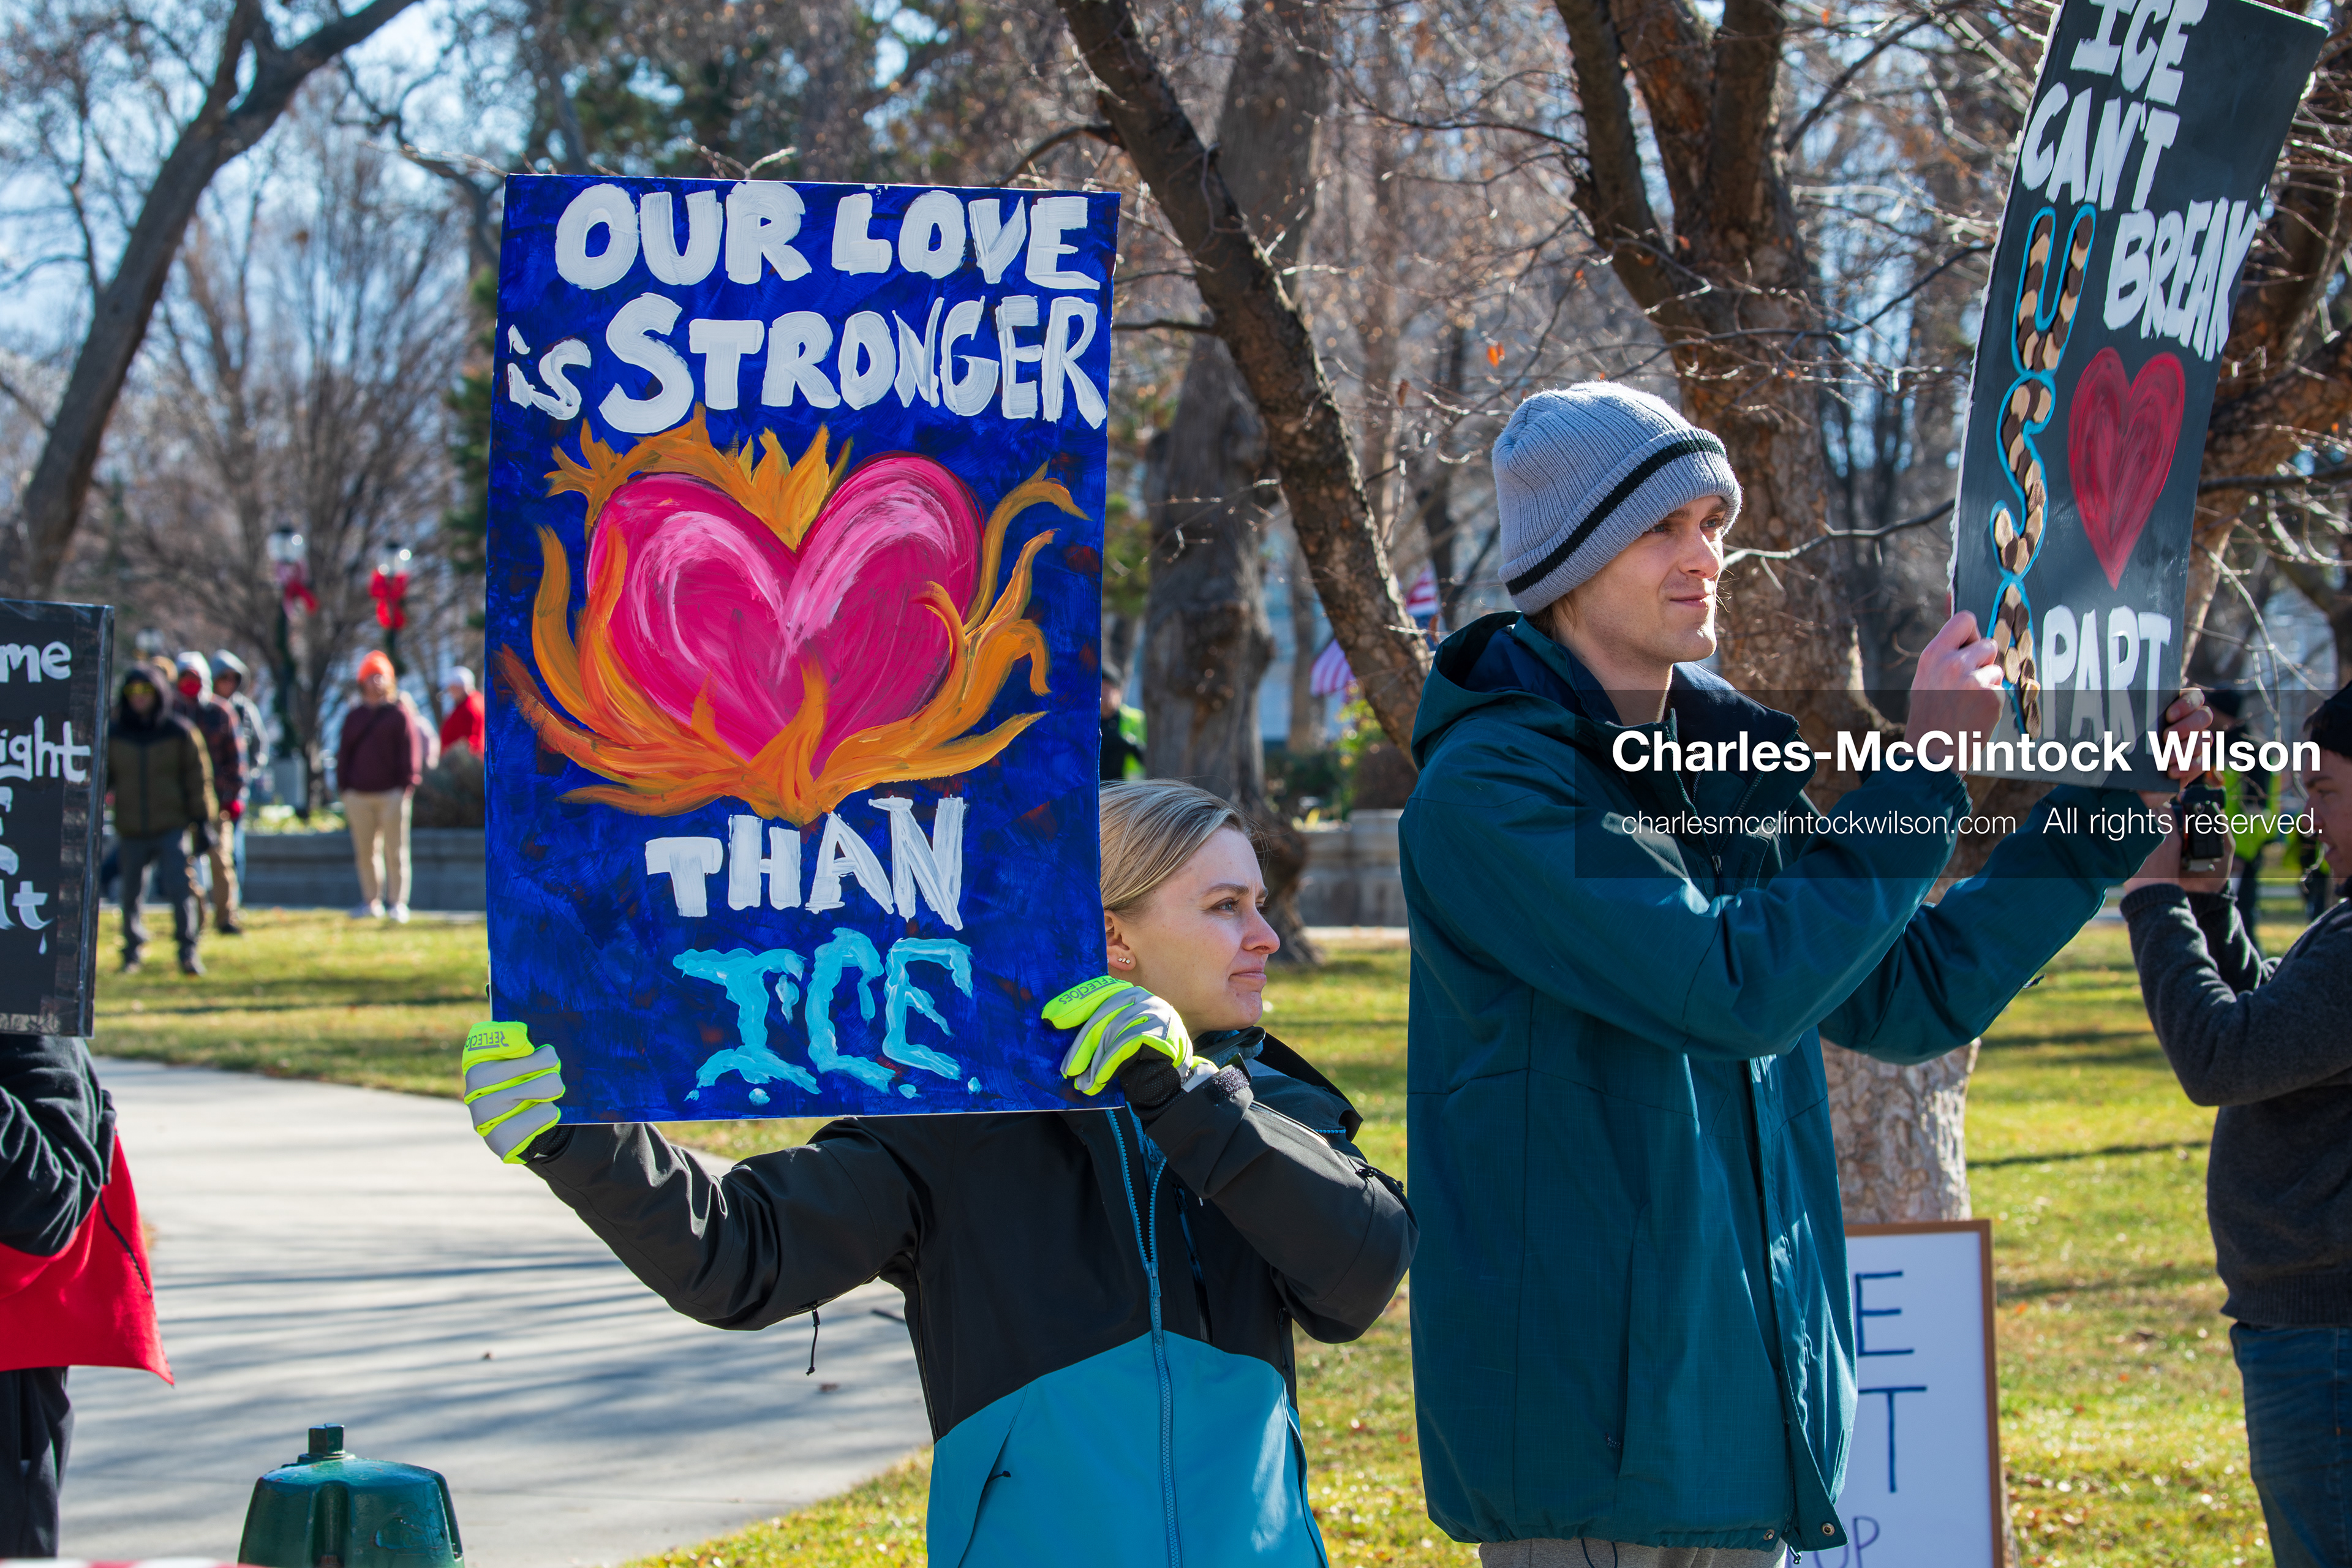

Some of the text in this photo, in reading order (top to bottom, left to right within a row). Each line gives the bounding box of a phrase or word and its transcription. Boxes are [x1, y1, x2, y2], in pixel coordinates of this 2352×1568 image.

[2070, 0, 2208, 106] ICE
[2021, 82, 2180, 212] CAN'T
[555, 181, 1101, 290] OUR LOVE
[2103, 196, 2260, 362] BREAK
[508, 292, 1107, 434] is STRONGER
[645, 795, 965, 931] THAN
